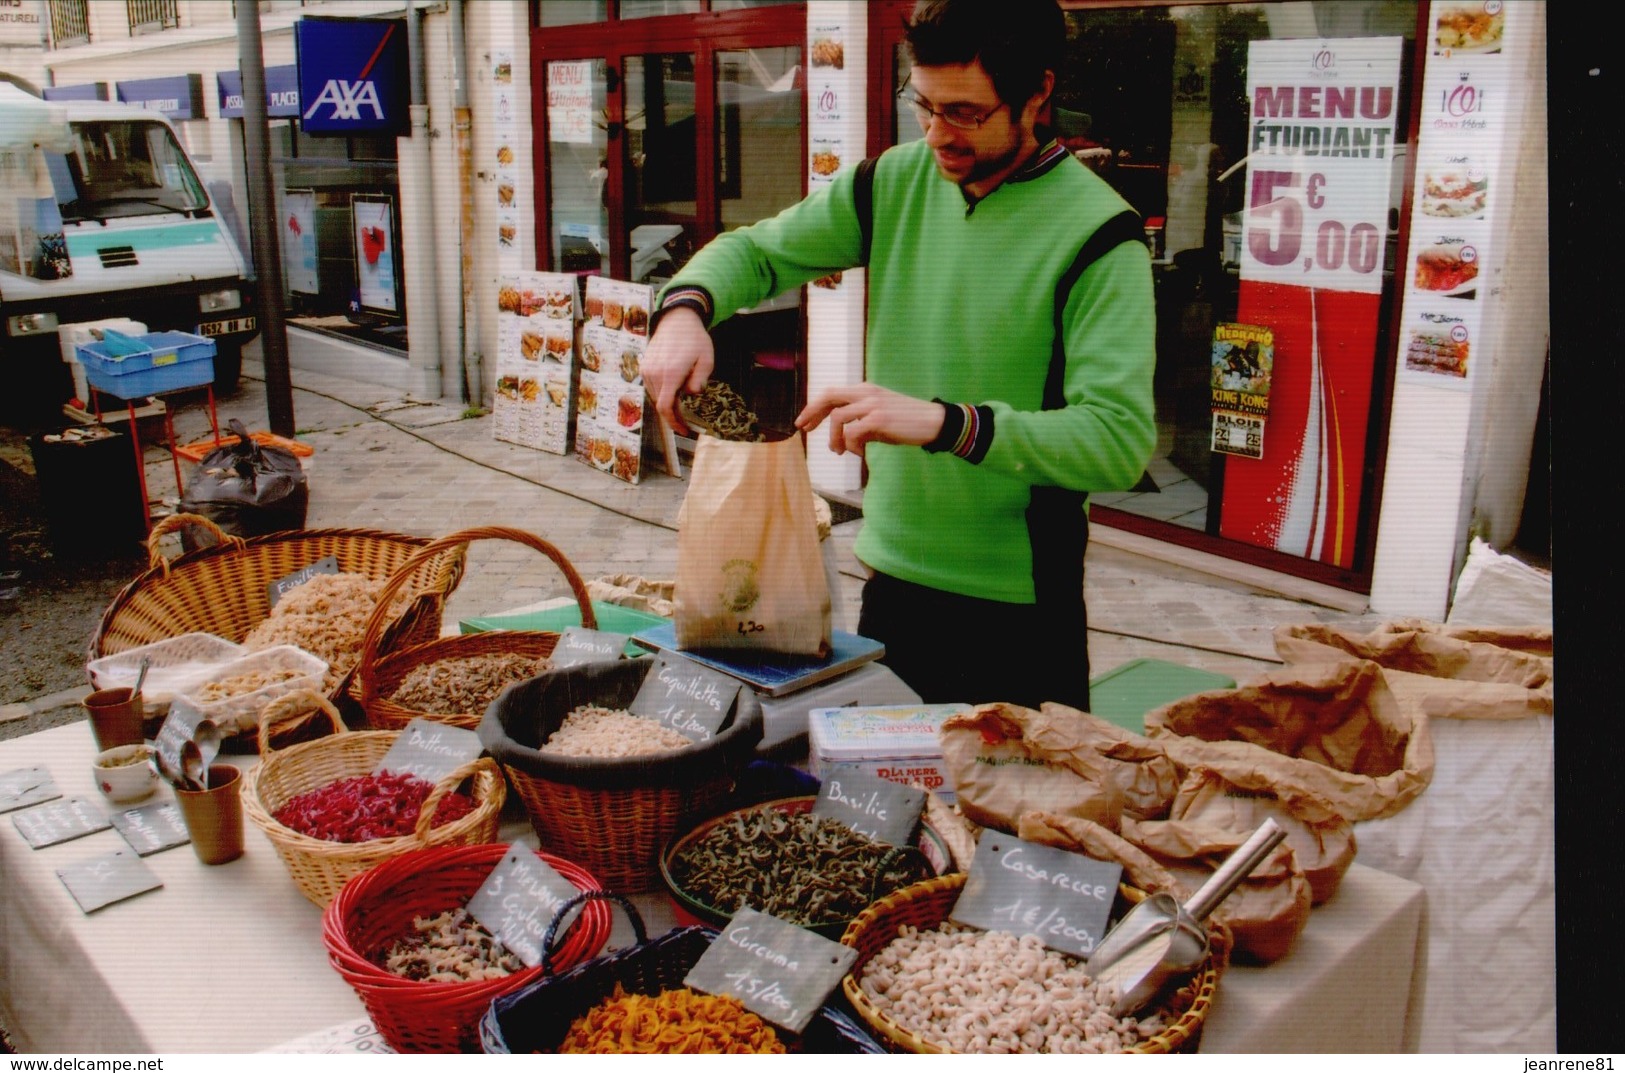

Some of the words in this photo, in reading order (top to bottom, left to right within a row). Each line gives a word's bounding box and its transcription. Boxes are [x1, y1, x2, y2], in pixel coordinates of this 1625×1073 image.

[303, 79, 385, 120] AXA
[1253, 86, 1393, 119] MENU
[1252, 120, 1391, 159] ÉTUDIANT
[1212, 389, 1237, 405] KING
[1240, 393, 1269, 410] KONG
[1217, 414, 1261, 429] BLOIS
[1247, 433, 1260, 447] 25
[658, 667, 722, 711] Coquillettes
[992, 899, 1095, 953] 1€/200g
[729, 926, 799, 971] Curcuma
